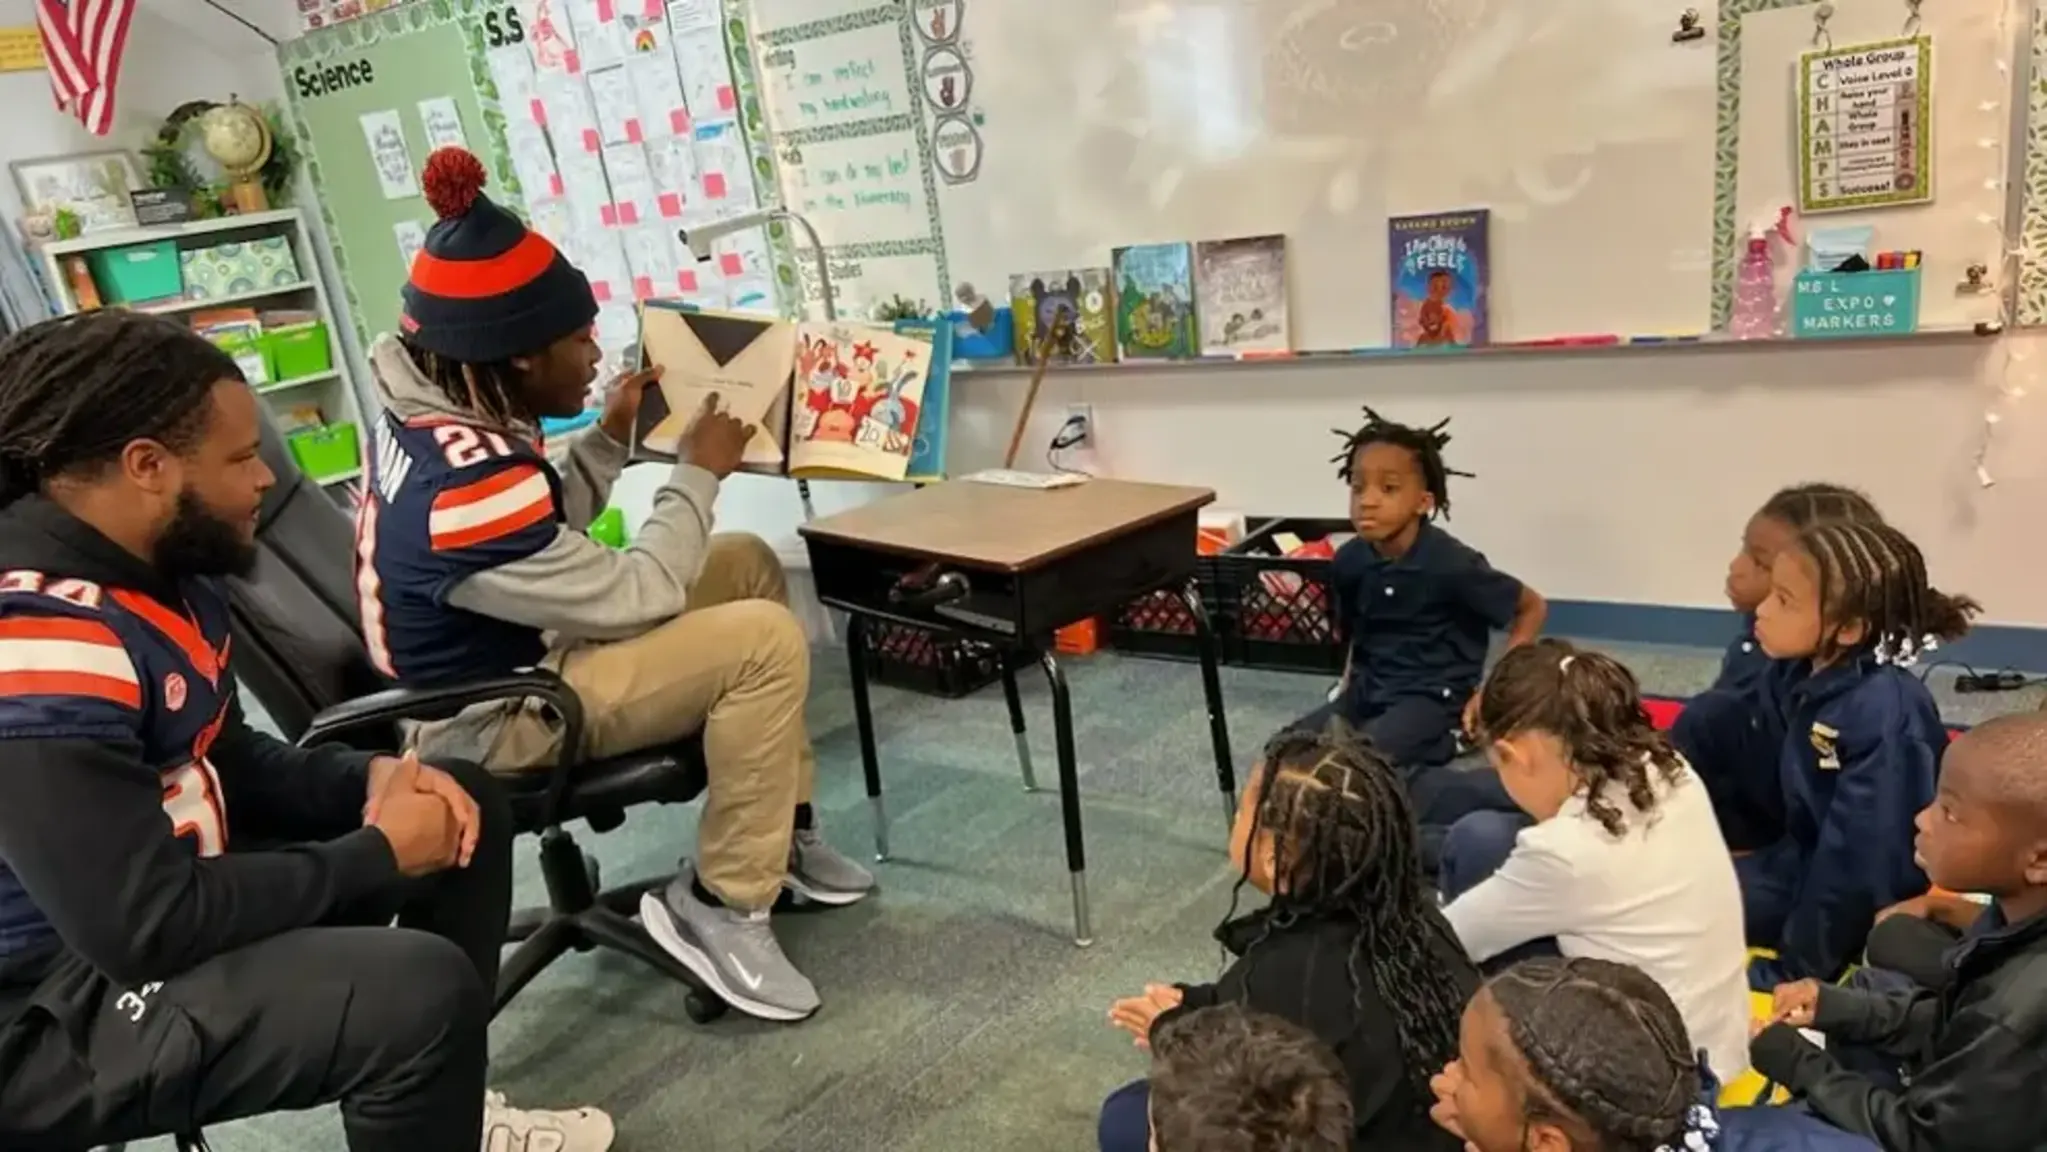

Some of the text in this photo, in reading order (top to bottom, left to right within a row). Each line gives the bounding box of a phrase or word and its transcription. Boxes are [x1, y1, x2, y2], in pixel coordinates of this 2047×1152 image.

[1823, 51, 1906, 70] Whole Group
[295, 58, 374, 97] Science
[1817, 73, 1829, 89] C
[1840, 75, 1869, 86] Voice
[1872, 68, 1903, 80] Level
[1816, 96, 1829, 112] H
[1816, 119, 1831, 134] A
[1814, 139, 1832, 156] M
[1818, 162, 1829, 177] P
[1818, 182, 1830, 197] S
[1823, 296, 1875, 311] EXPO
[1803, 312, 1895, 329] MARKERS
[433, 414, 513, 469] 21
